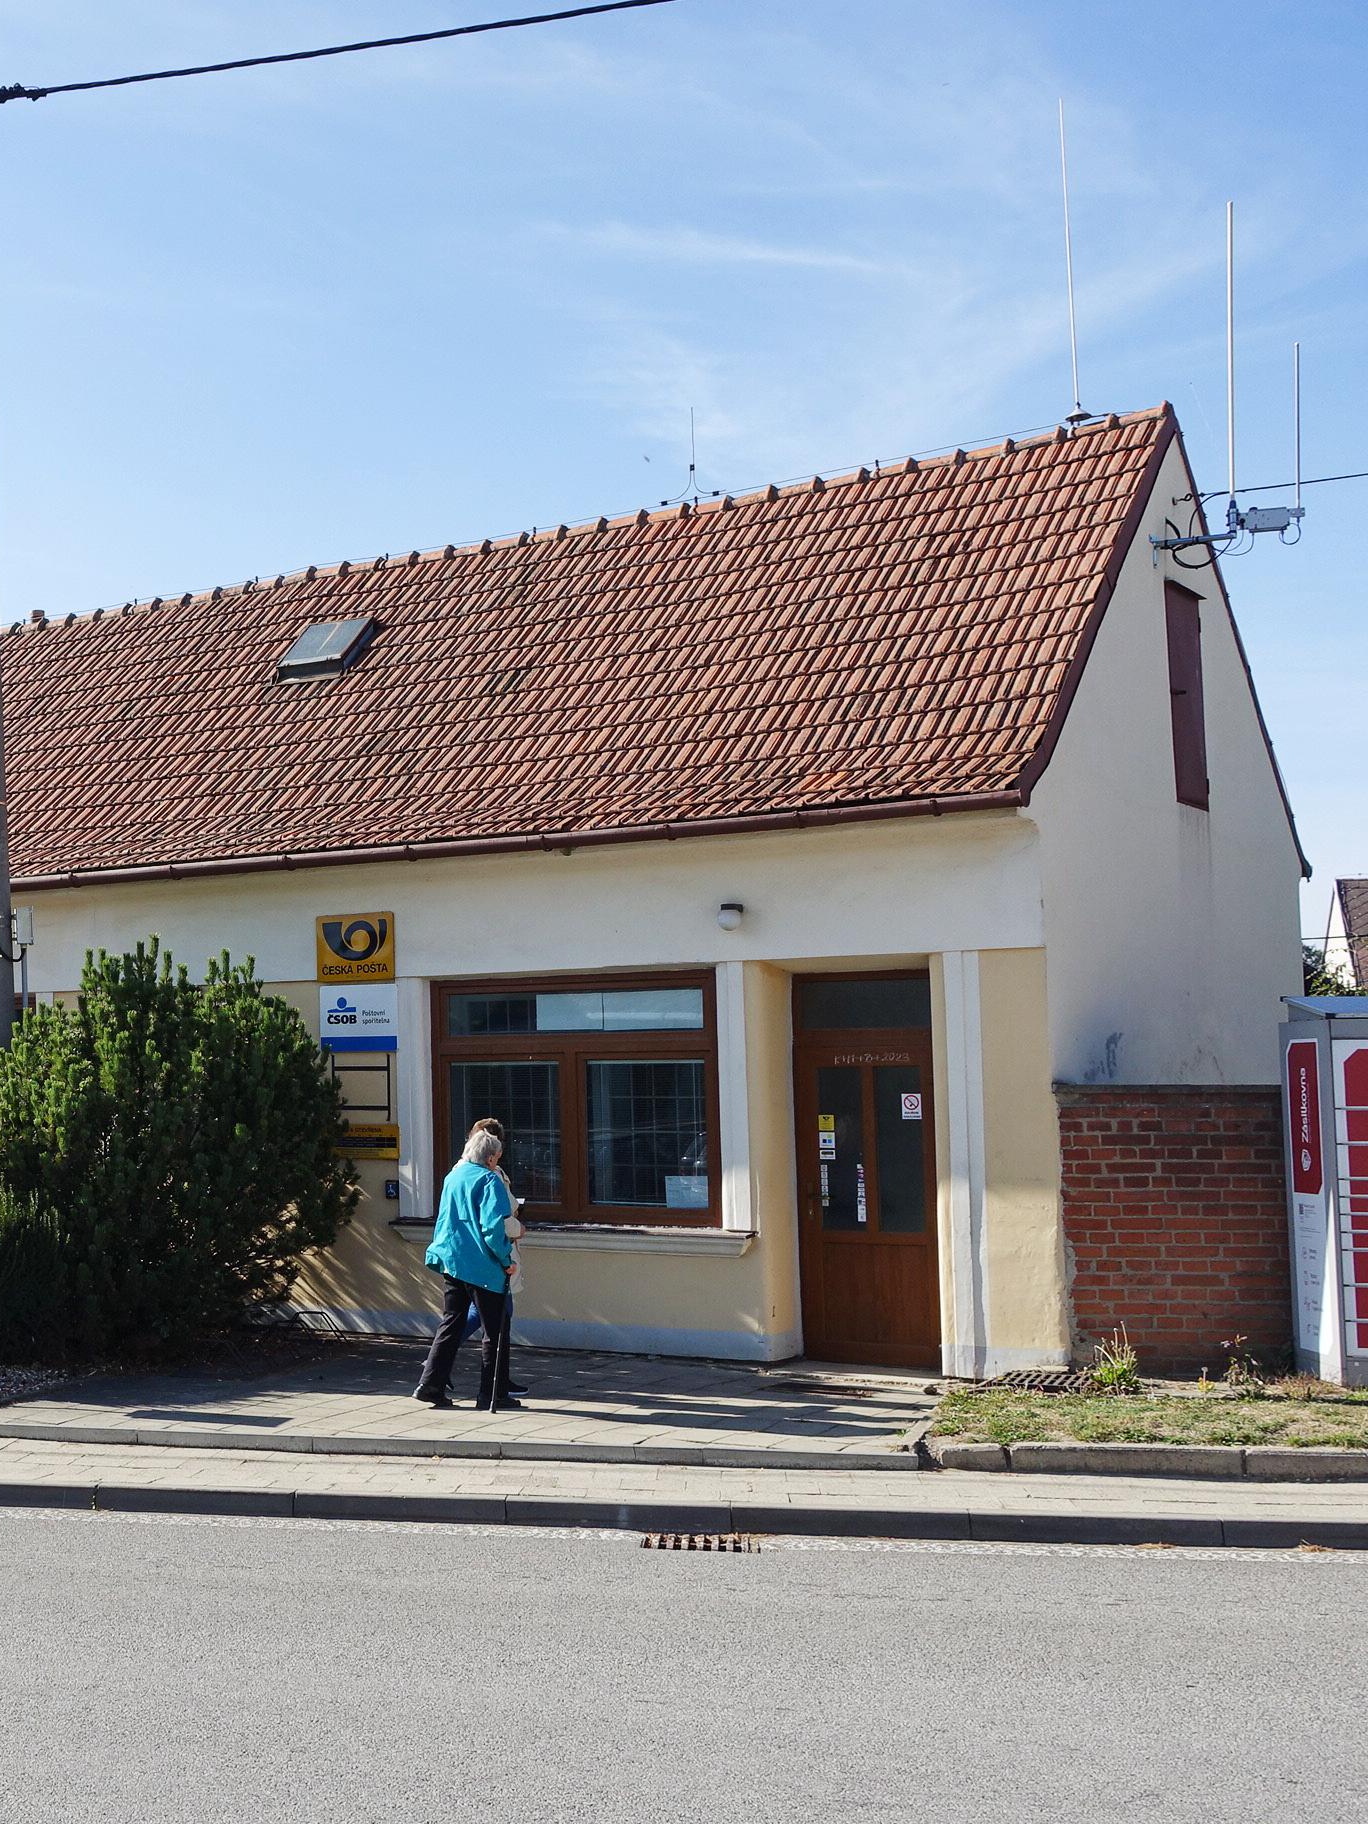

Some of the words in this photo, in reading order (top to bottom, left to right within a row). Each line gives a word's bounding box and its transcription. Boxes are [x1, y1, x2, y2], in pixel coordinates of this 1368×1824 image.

[322, 962, 353, 976] ČESKÁ
[356, 961, 388, 974] POŠTA
[327, 1014, 357, 1025] ČSOB
[1300, 1067, 1309, 1143] Zásilkovna
